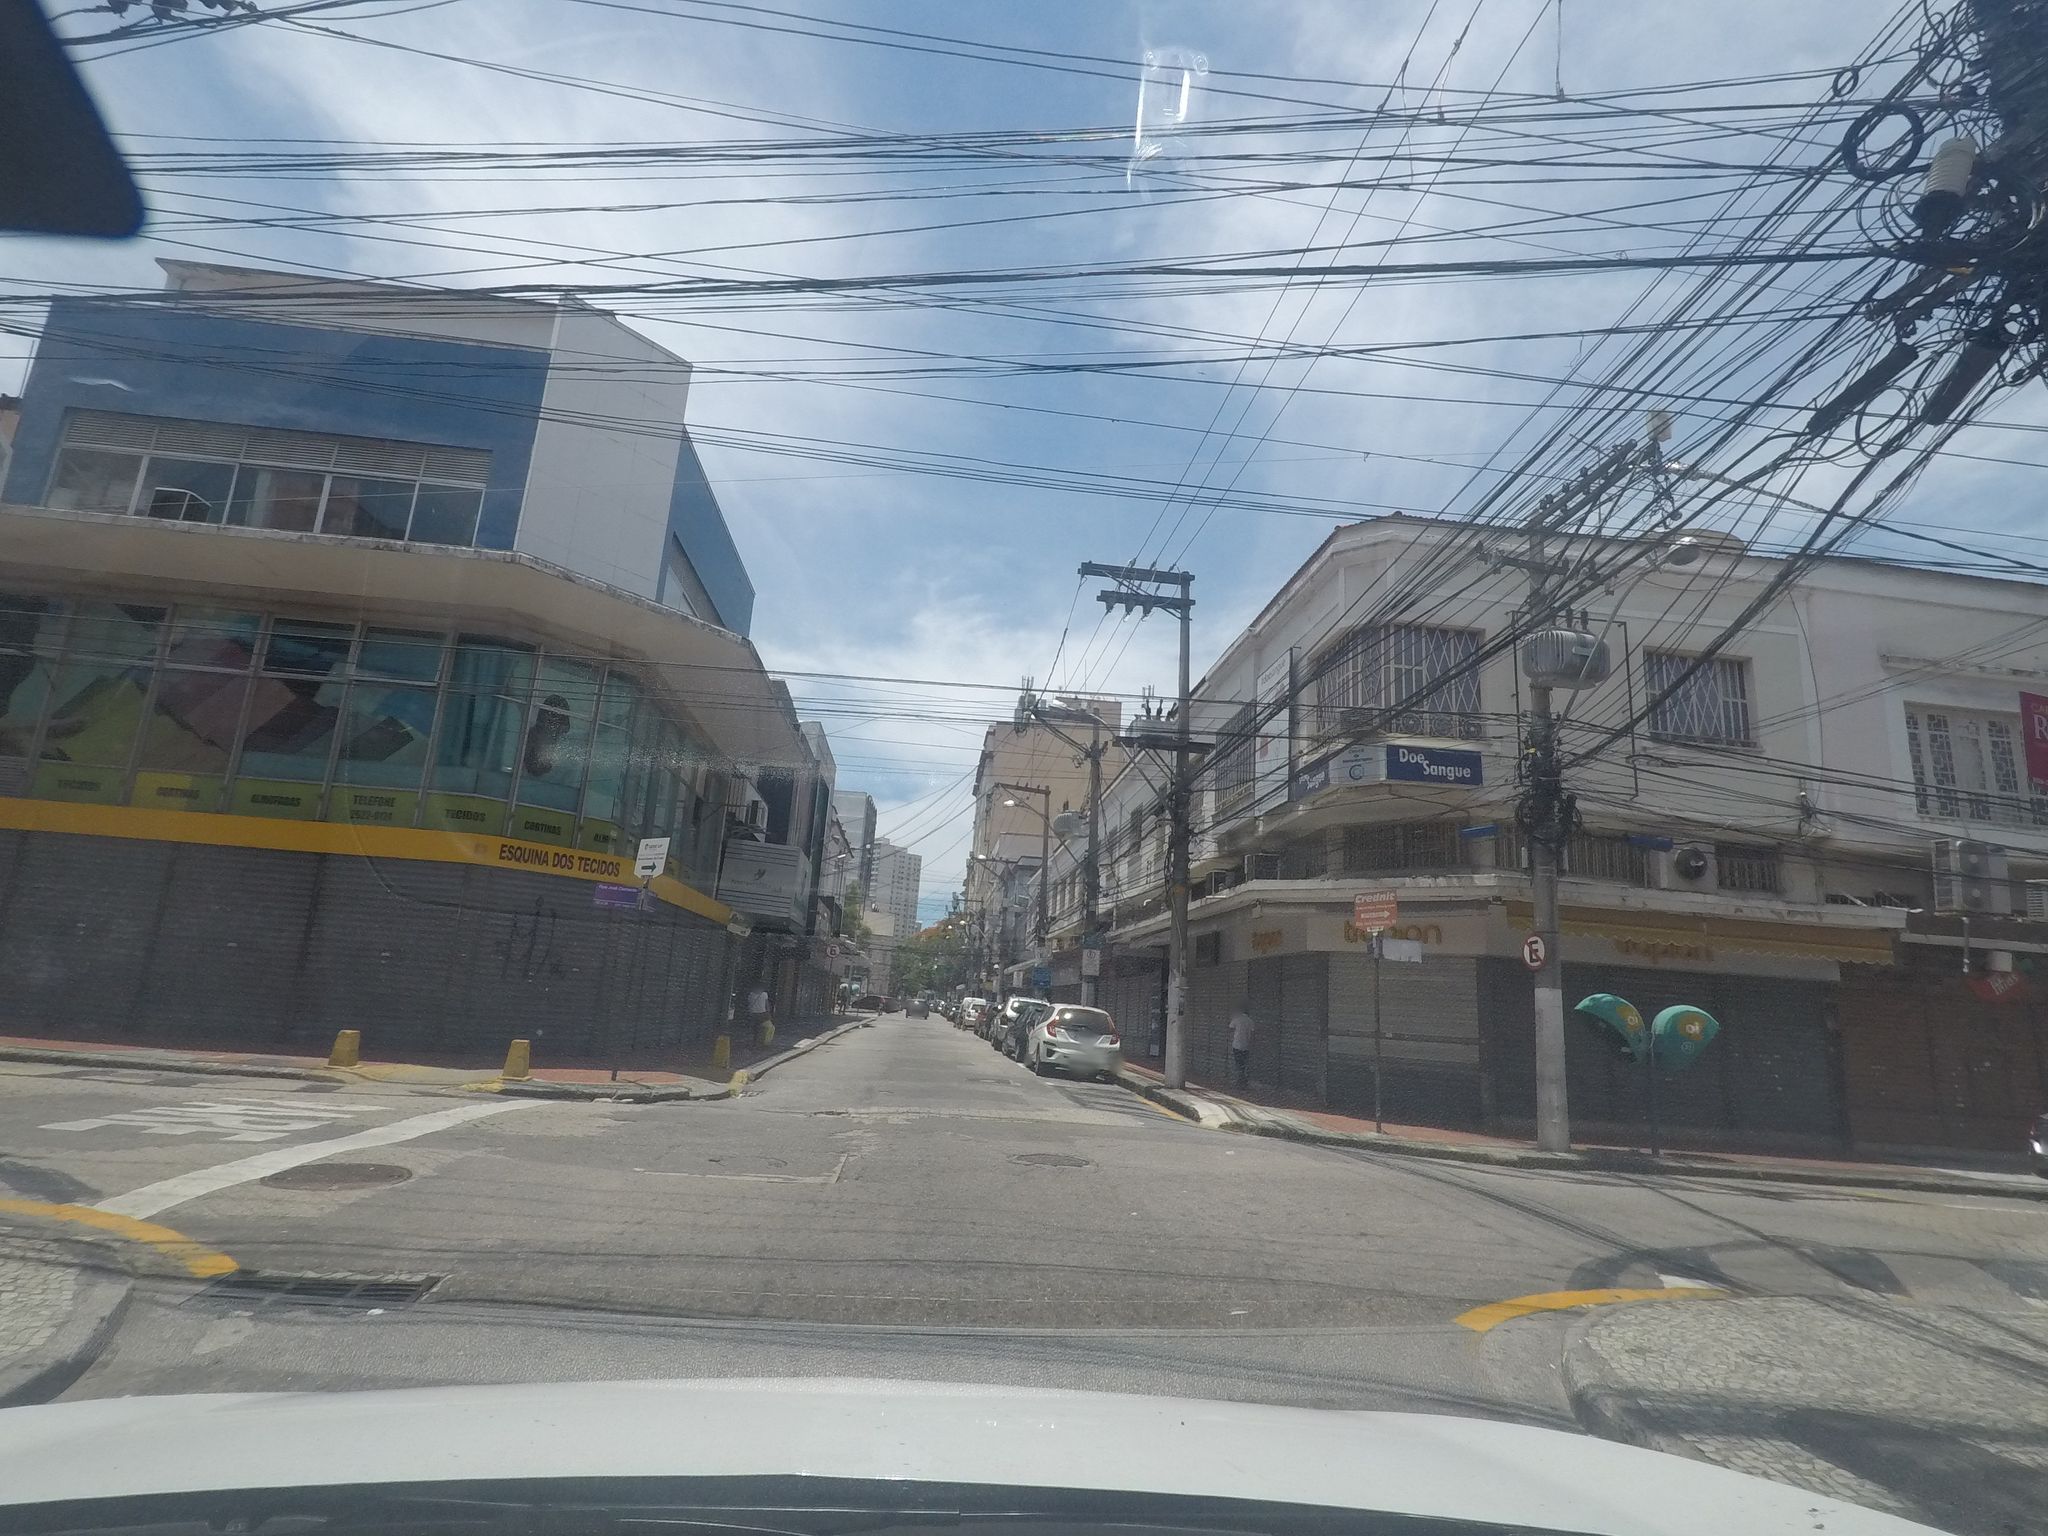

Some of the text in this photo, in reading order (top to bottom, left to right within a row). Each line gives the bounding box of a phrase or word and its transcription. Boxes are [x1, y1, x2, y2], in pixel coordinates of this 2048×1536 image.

[1399, 749, 1424, 763] Doe
[1423, 761, 1471, 780] Sangue
[353, 794, 396, 808] TELEFONE
[445, 808, 486, 822] TECIDOS
[524, 820, 562, 836] CORTINAS
[499, 843, 620, 877] ESQUINA DOS TECIDOS
[1685, 1020, 1700, 1034] oi
